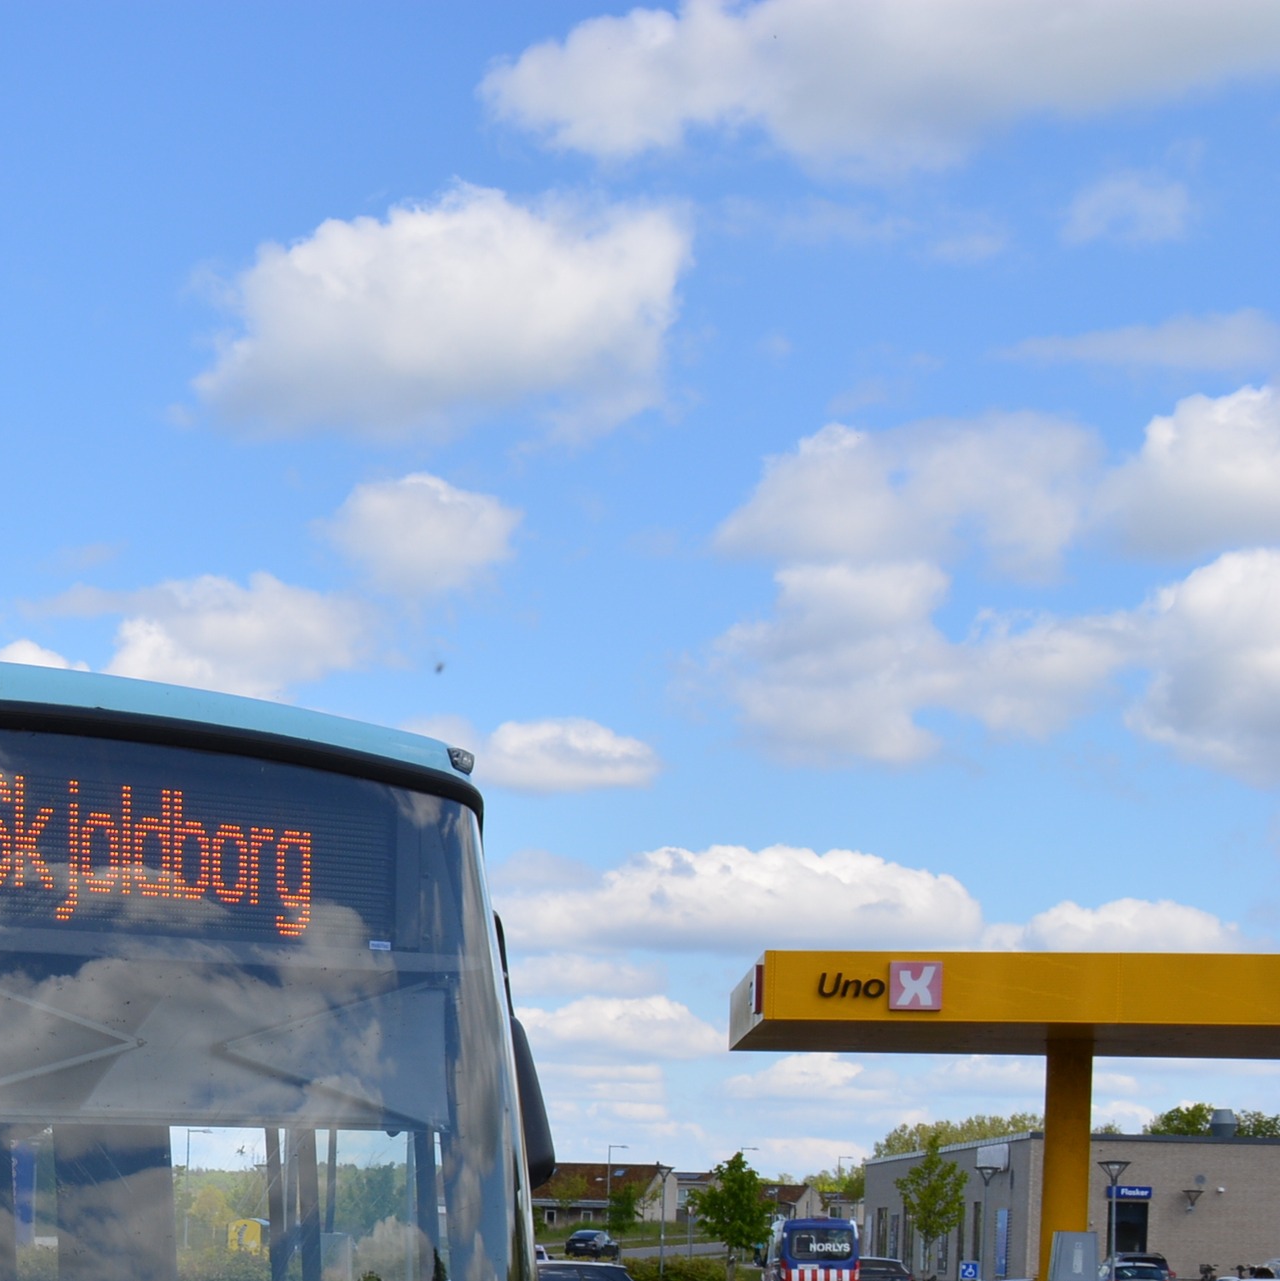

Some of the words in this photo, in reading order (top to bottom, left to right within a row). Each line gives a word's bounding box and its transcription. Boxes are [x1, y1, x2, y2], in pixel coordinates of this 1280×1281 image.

[817, 972, 886, 999] Uno
[897, 966, 936, 1005] X
[809, 1242, 851, 1252] NORLYS
